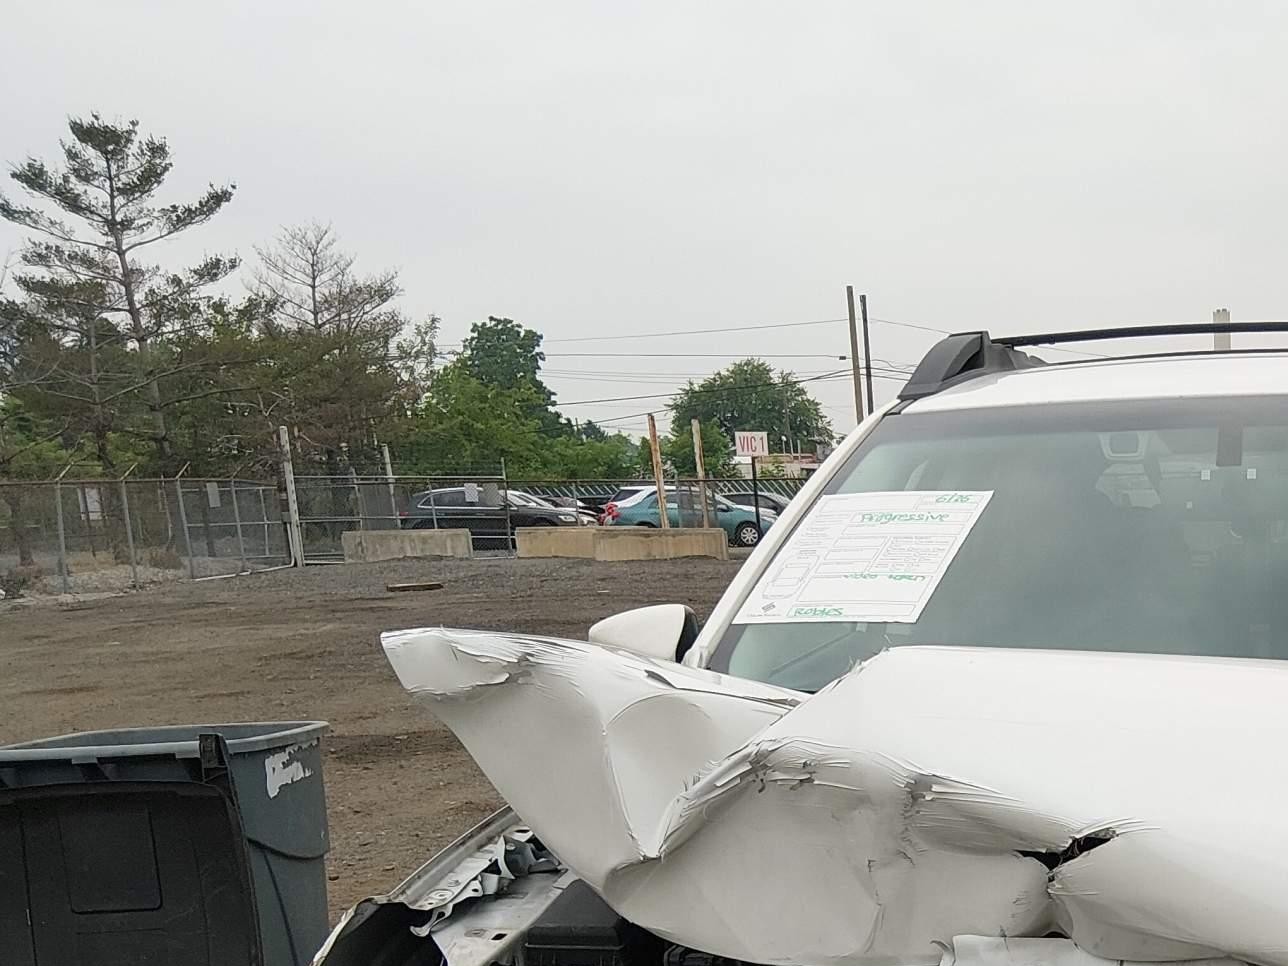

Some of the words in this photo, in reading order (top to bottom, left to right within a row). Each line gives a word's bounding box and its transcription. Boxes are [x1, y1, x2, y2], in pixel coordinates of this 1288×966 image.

[738, 435, 757, 452] VIC
[760, 435, 765, 452] 1
[860, 511, 950, 524] Progressive
